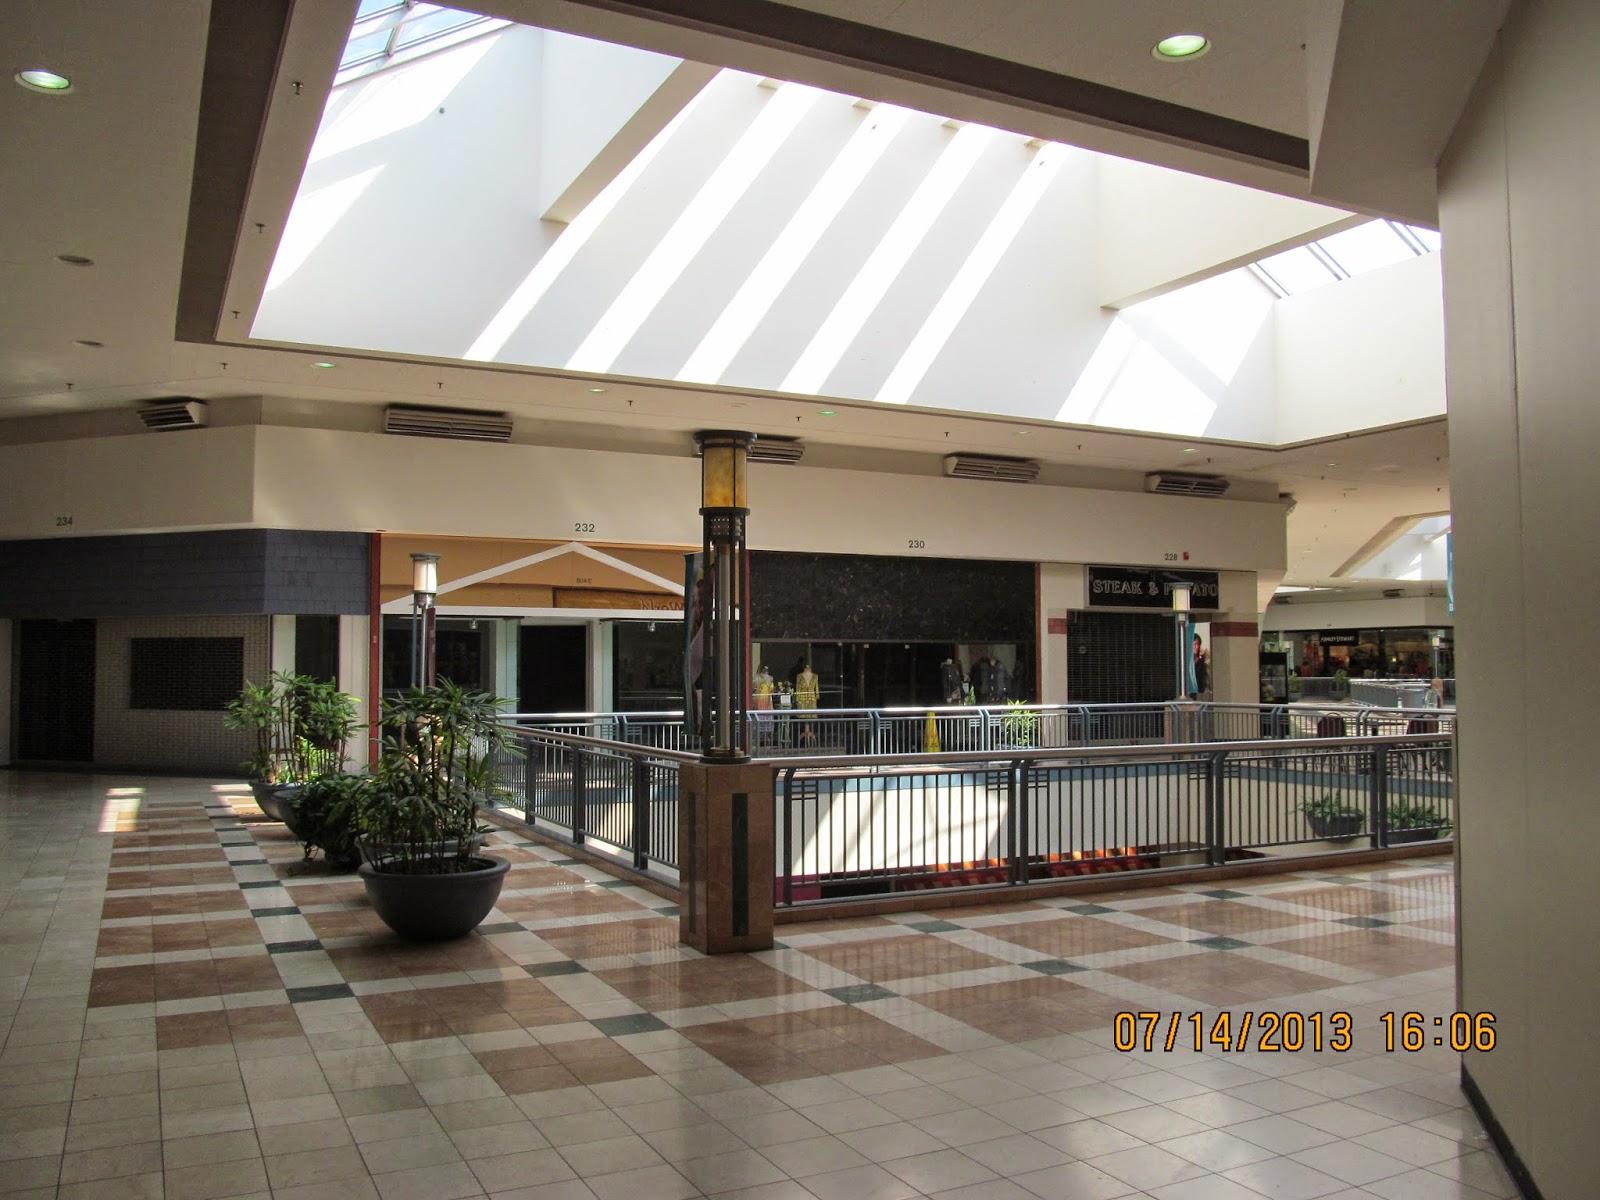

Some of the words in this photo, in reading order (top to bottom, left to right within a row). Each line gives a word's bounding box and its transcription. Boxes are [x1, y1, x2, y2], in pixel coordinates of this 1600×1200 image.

[56, 517, 72, 526] 234
[574, 522, 595, 533] 232
[908, 539, 926, 549] 230
[1164, 553, 1178, 561] 228
[1092, 579, 1143, 595] STEAK
[1148, 581, 1159, 596] &
[1163, 582, 1219, 597] PATO
